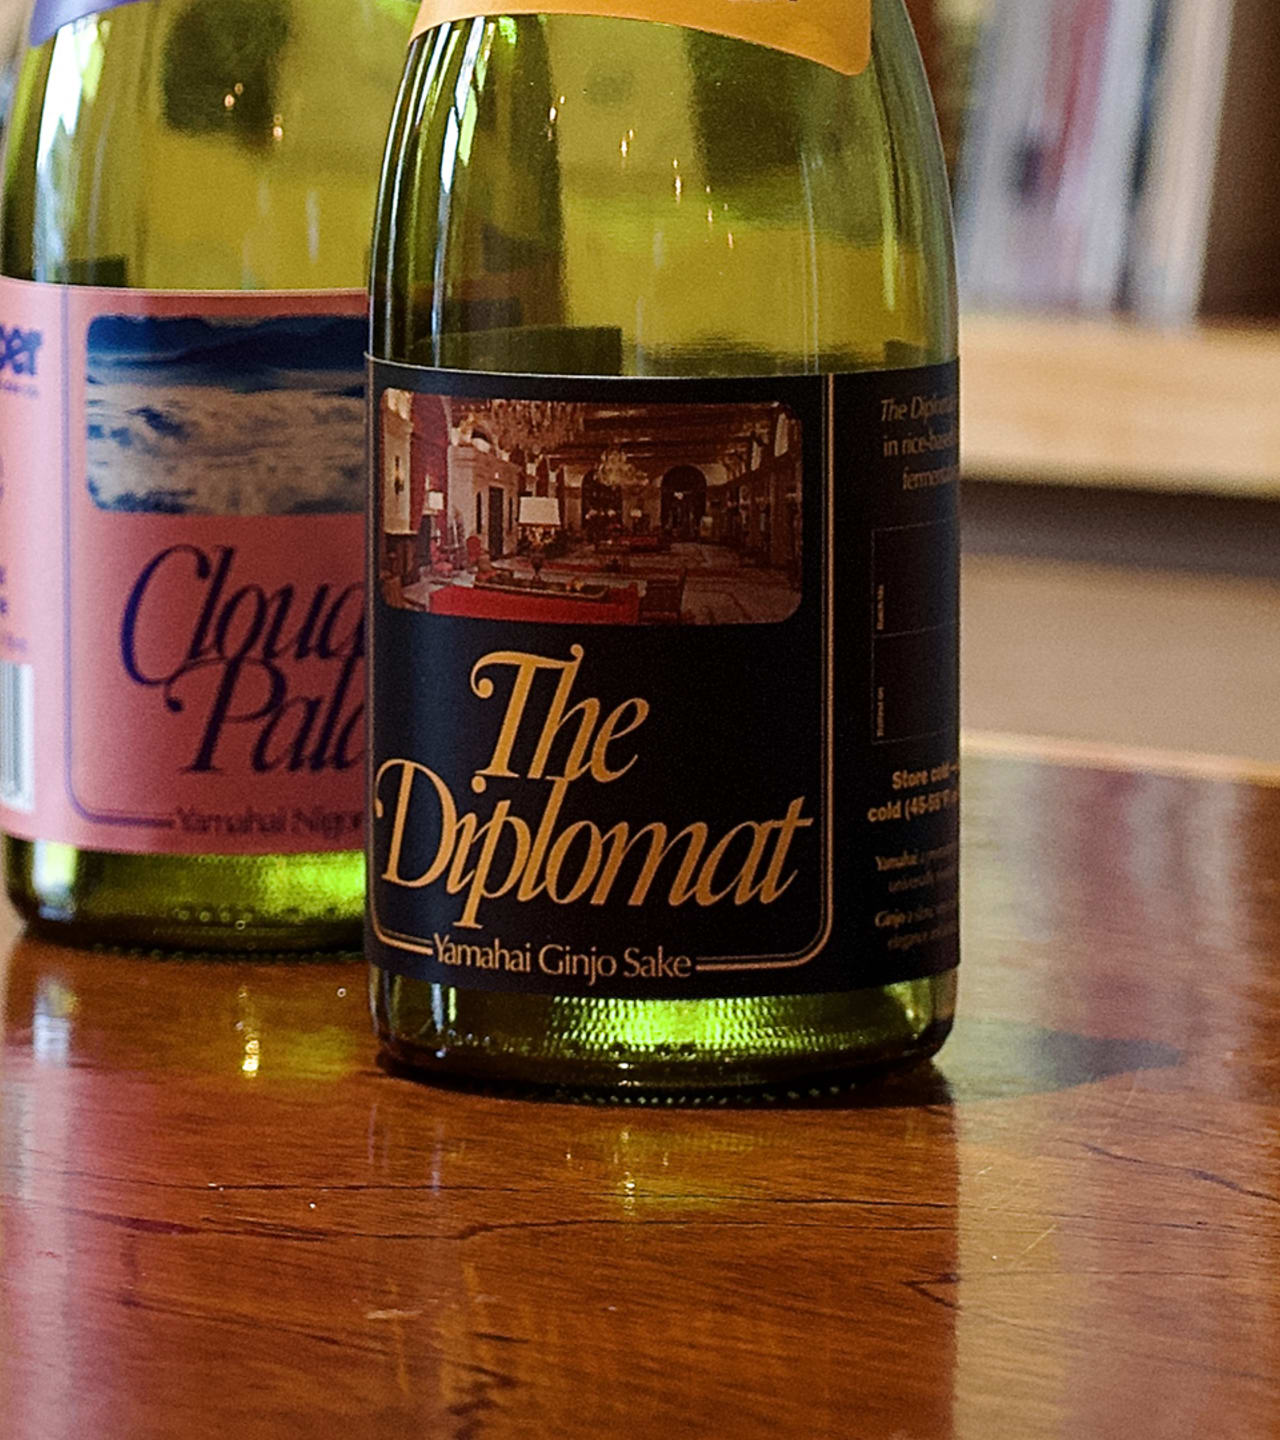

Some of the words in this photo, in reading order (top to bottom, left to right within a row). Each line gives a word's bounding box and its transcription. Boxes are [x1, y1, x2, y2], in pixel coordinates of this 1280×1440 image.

[470, 644, 650, 783] The
[373, 758, 814, 930] Diplomat
[867, 800, 903, 823] cold
[433, 933, 532, 974] Yamahai
[538, 944, 618, 987] Ginjo
[623, 945, 693, 978] Sake
